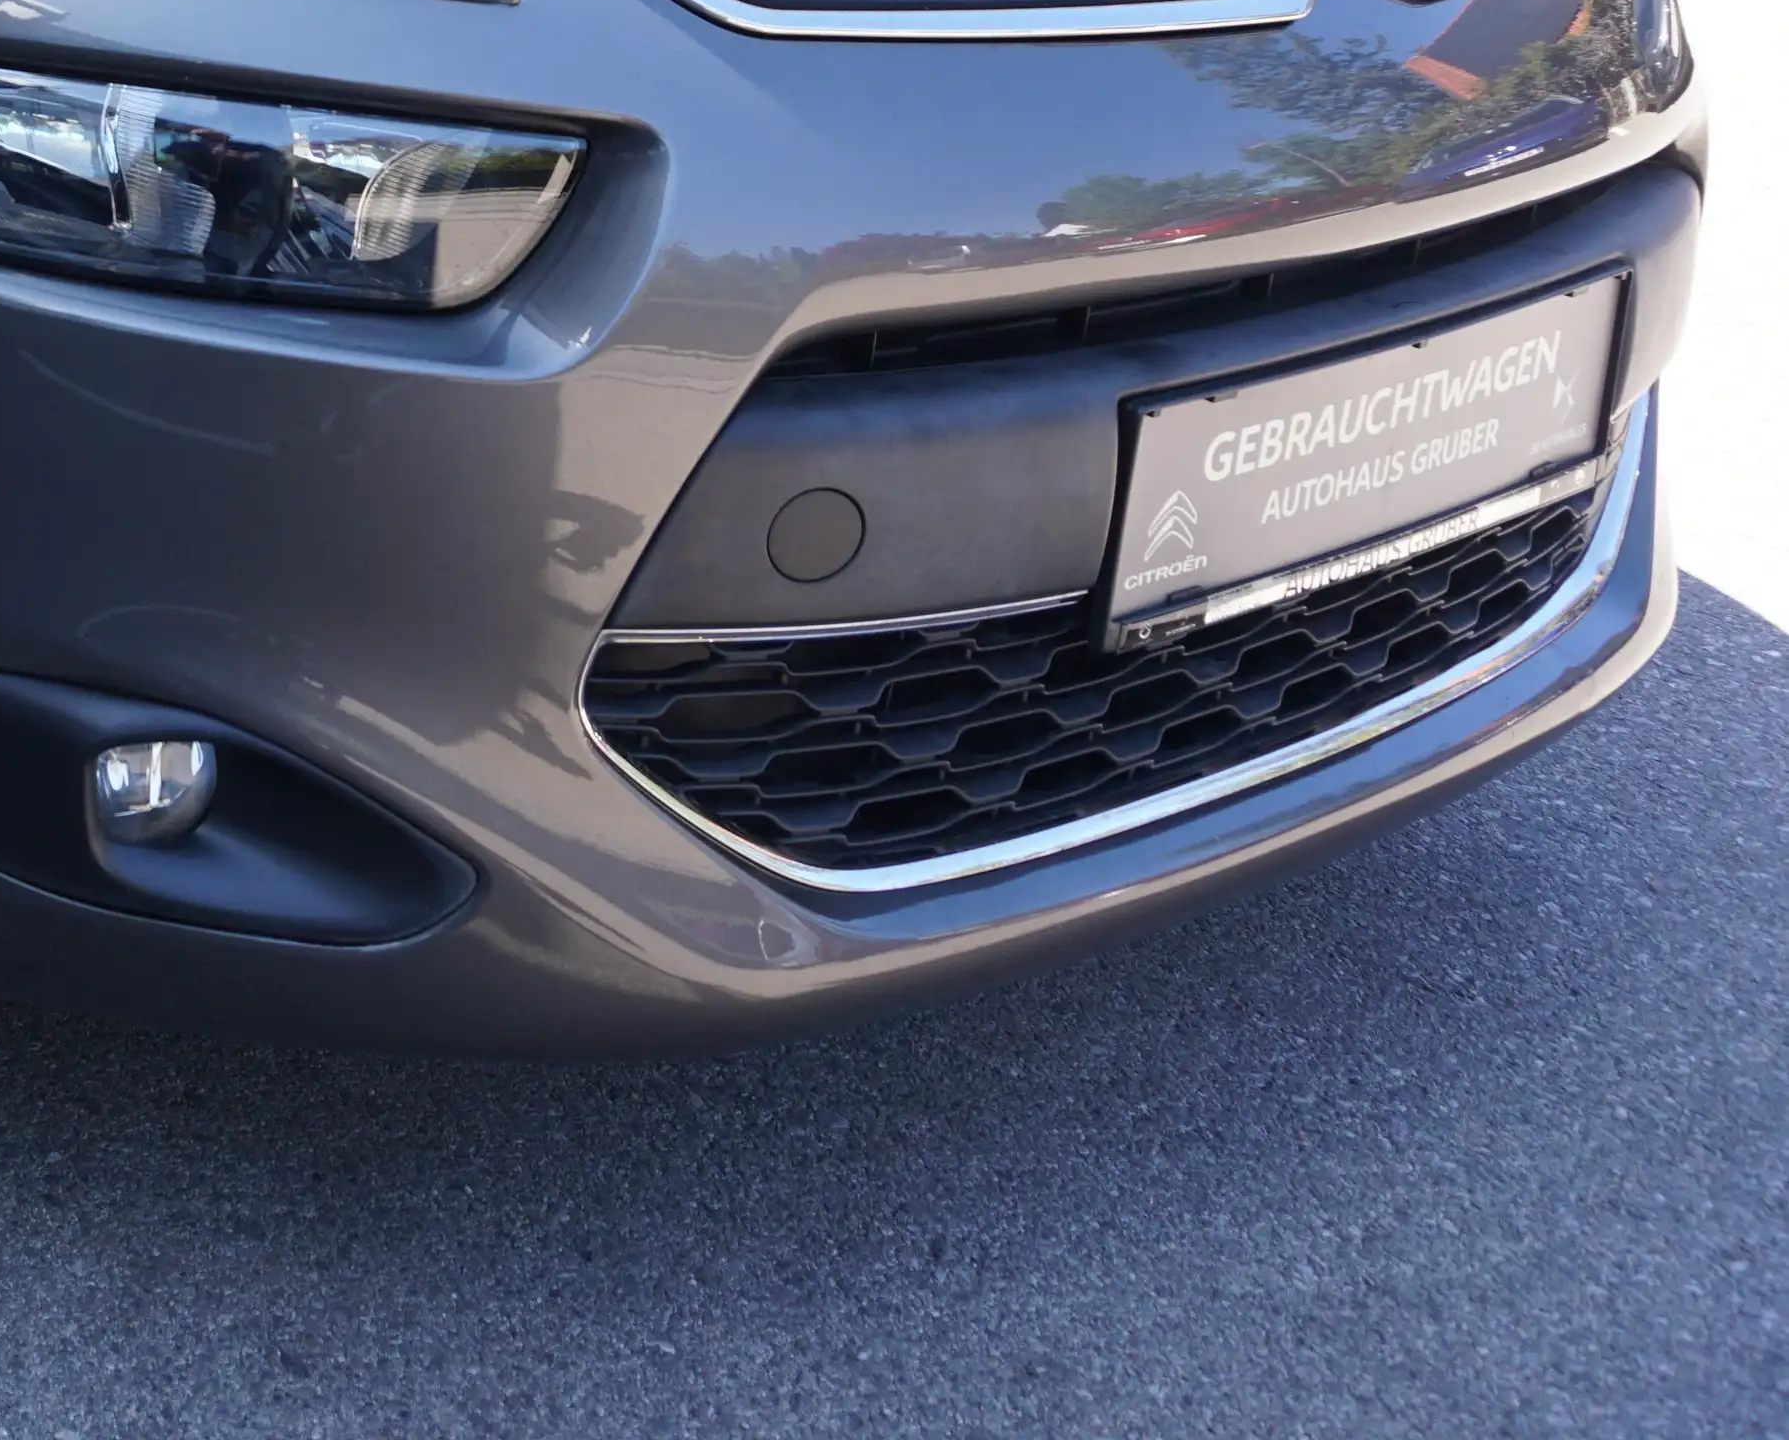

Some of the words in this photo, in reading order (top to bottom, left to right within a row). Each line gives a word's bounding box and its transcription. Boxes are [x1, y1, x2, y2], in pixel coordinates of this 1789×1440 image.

[1204, 330, 1561, 482] GEBRAUCHTWAGEN
[1261, 450, 1406, 525] AUTOHAUS
[1411, 418, 1500, 475] GRUBER
